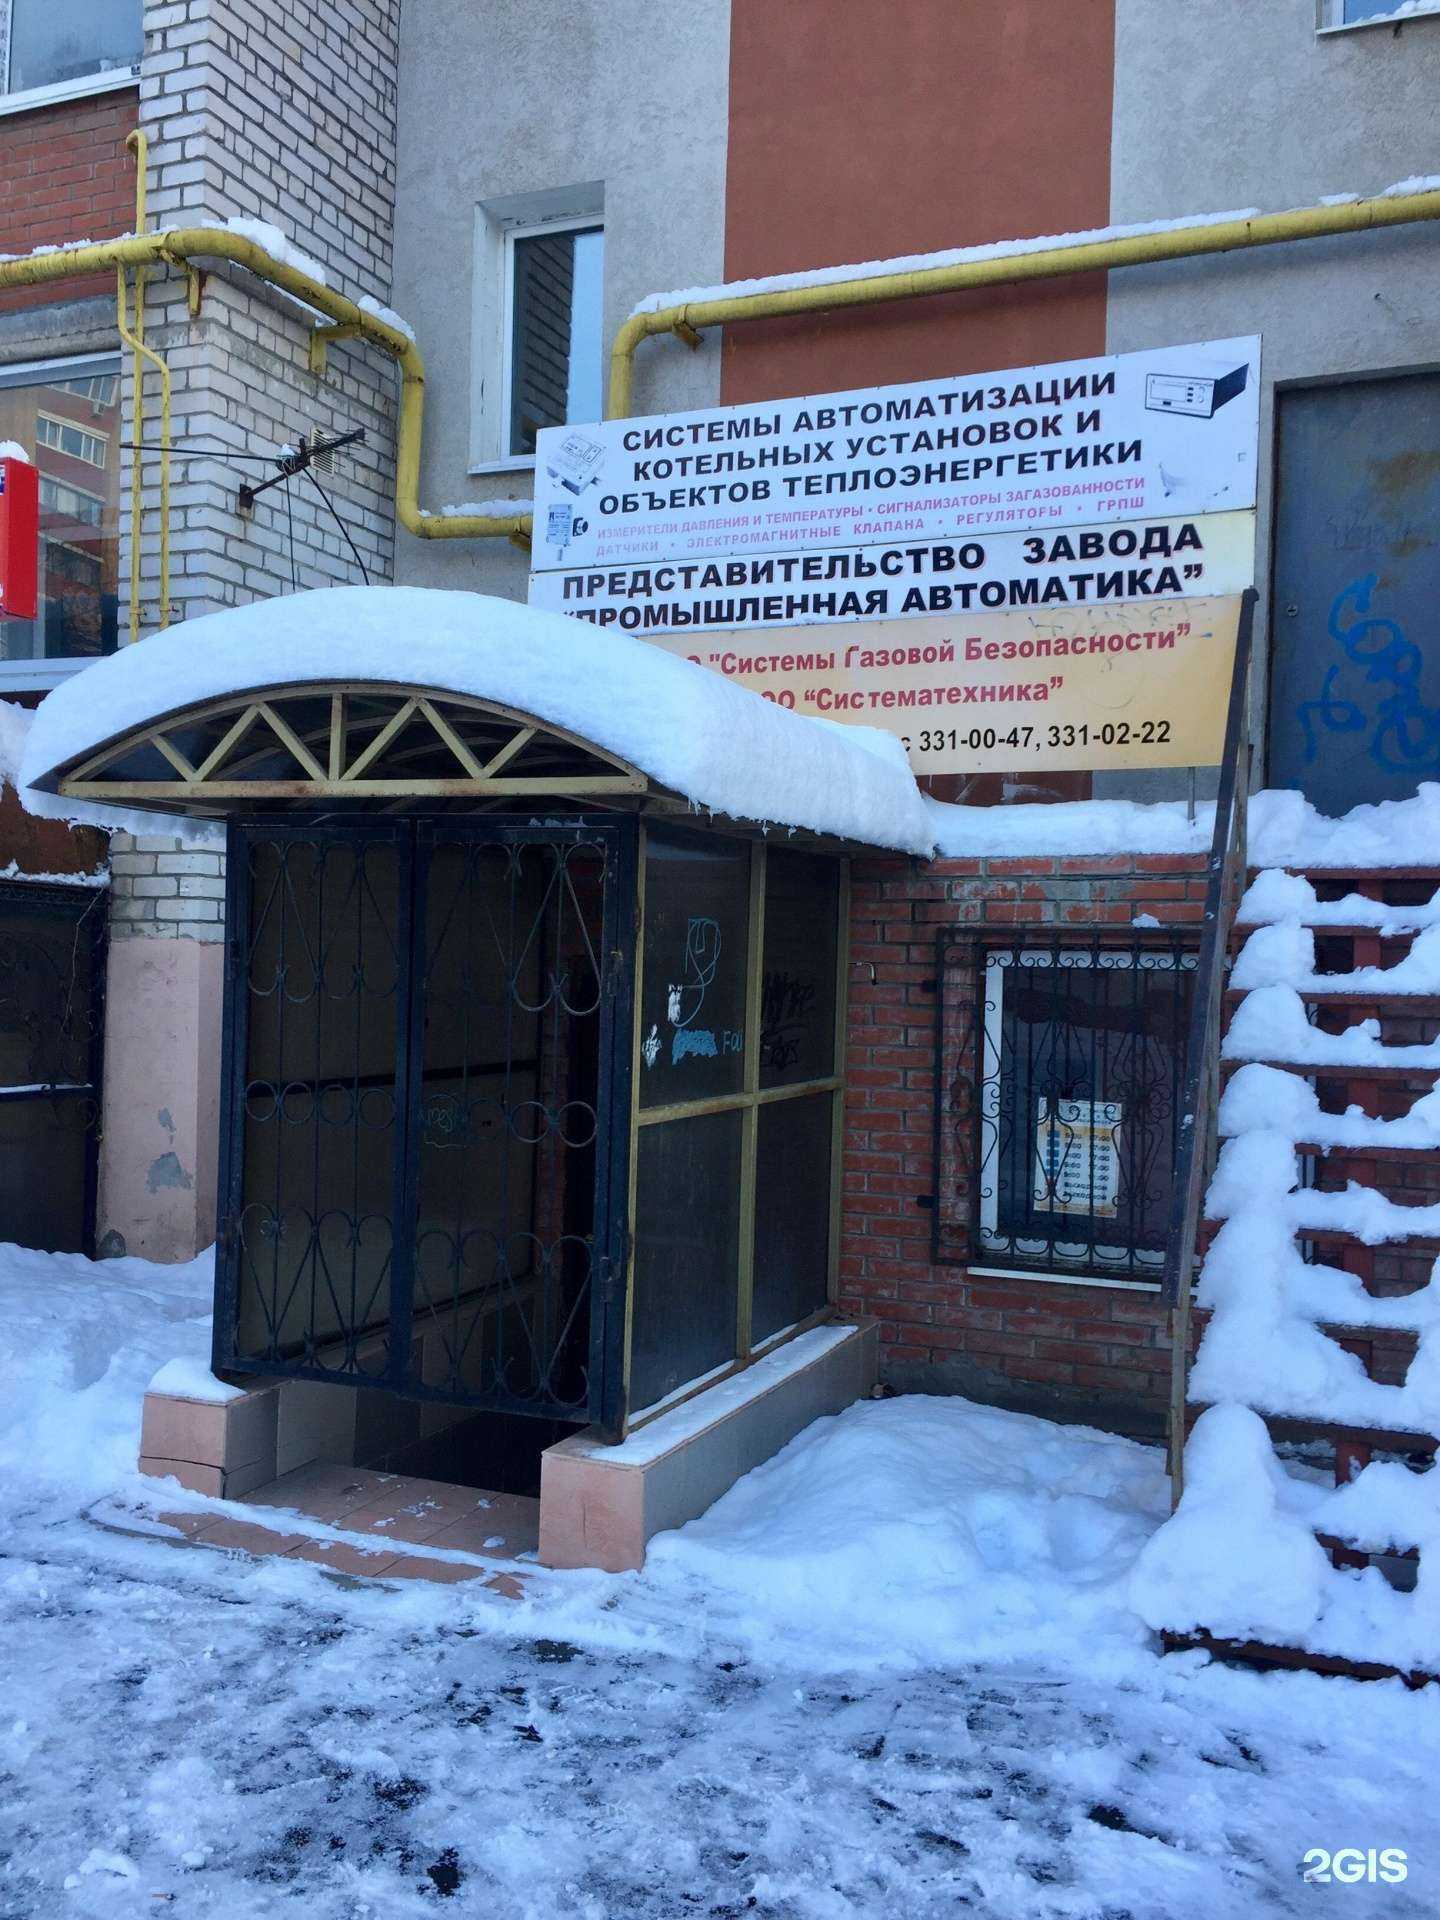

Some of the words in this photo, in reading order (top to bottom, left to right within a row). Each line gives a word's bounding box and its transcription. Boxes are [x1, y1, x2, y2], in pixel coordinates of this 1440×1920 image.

[622, 414, 781, 451] СИСТЕМЫ
[792, 371, 1115, 433] АВТОМАТИЗАЦИИ
[599, 479, 771, 515] ОБЪЕКТОВ
[782, 439, 1142, 497] ТЕПЛОЭНЕРГЕТИКИ
[633, 440, 834, 482] КОТЕЛЬНЫХ
[846, 413, 1063, 460] УСТАНОВОК
[1076, 409, 1101, 434] И
[595, 540, 659, 557] ДАТЧИКИ
[686, 525, 841, 548] ЭЛЕКТРОМАГНИТНЫЕ
[853, 517, 924, 535] КЛАПАНА
[956, 505, 1062, 526] РЕГУЛЯТОРЫ
[1097, 496, 1145, 512] ГРПШ
[597, 523, 678, 539] ИЗМЕРИТЕЛИ
[681, 515, 750, 533] ДАВЛЕНИЯ
[753, 514, 762, 526] И
[765, 505, 863, 525] ТЕМПЕРАТУРЫ
[877, 493, 1001, 515] СИГНАЛИЗАТОРЫ
[1006, 477, 1145, 502] ЗАГАЗОВАННОСТИ
[563, 543, 985, 599] ПРЕДСТАВИТЕЛЬСТВО
[1023, 523, 1203, 564] ЗАВОДА
[844, 638, 954, 669] Газовой
[919, 726, 1041, 752] 331-00-47,
[1047, 720, 1171, 747] 331-02-22
